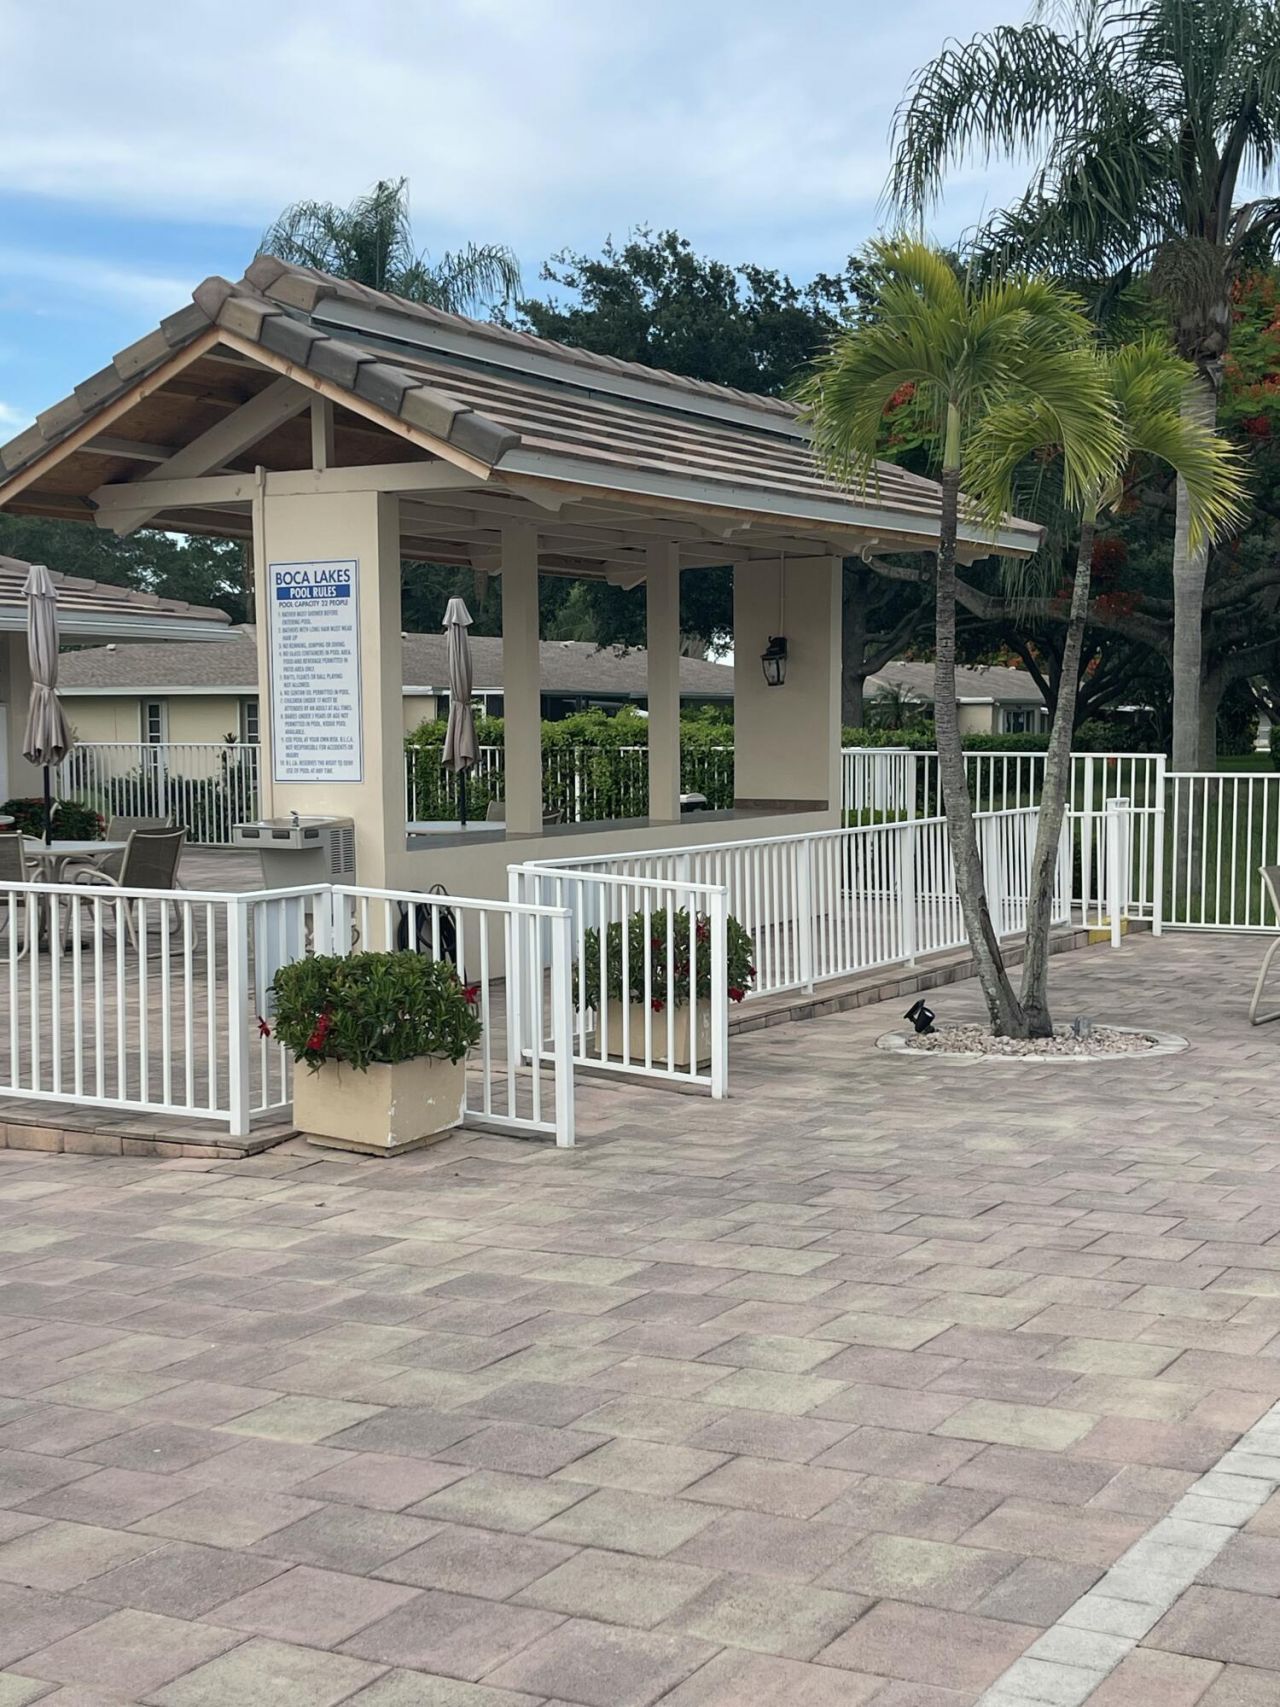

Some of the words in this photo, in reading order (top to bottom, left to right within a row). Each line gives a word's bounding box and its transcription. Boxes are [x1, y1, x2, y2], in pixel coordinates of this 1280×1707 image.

[276, 570, 310, 585] BOCA
[314, 569, 350, 584] LAKES
[290, 588, 311, 598] POOL
[313, 586, 336, 597] RULES
